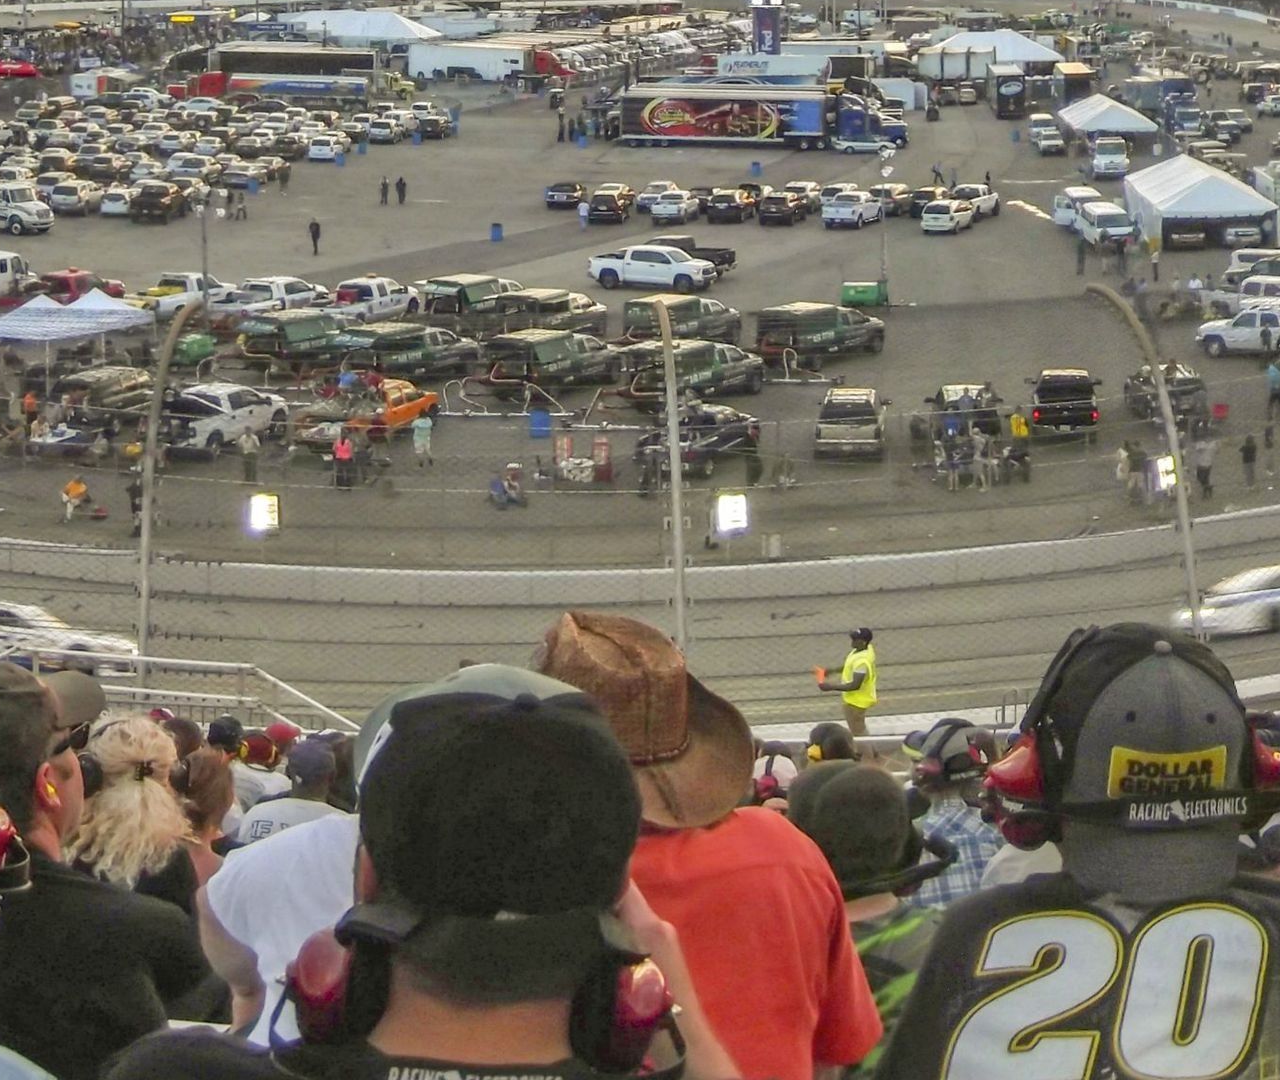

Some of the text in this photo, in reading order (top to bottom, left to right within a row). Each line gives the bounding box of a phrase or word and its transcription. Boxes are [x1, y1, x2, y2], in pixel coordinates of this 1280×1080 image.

[1126, 758, 1214, 778] DOLLAR
[1119, 776, 1215, 796] GENERAL
[1129, 796, 1248, 821] RACING ELECTRONICS
[941, 902, 1270, 1080] 20
